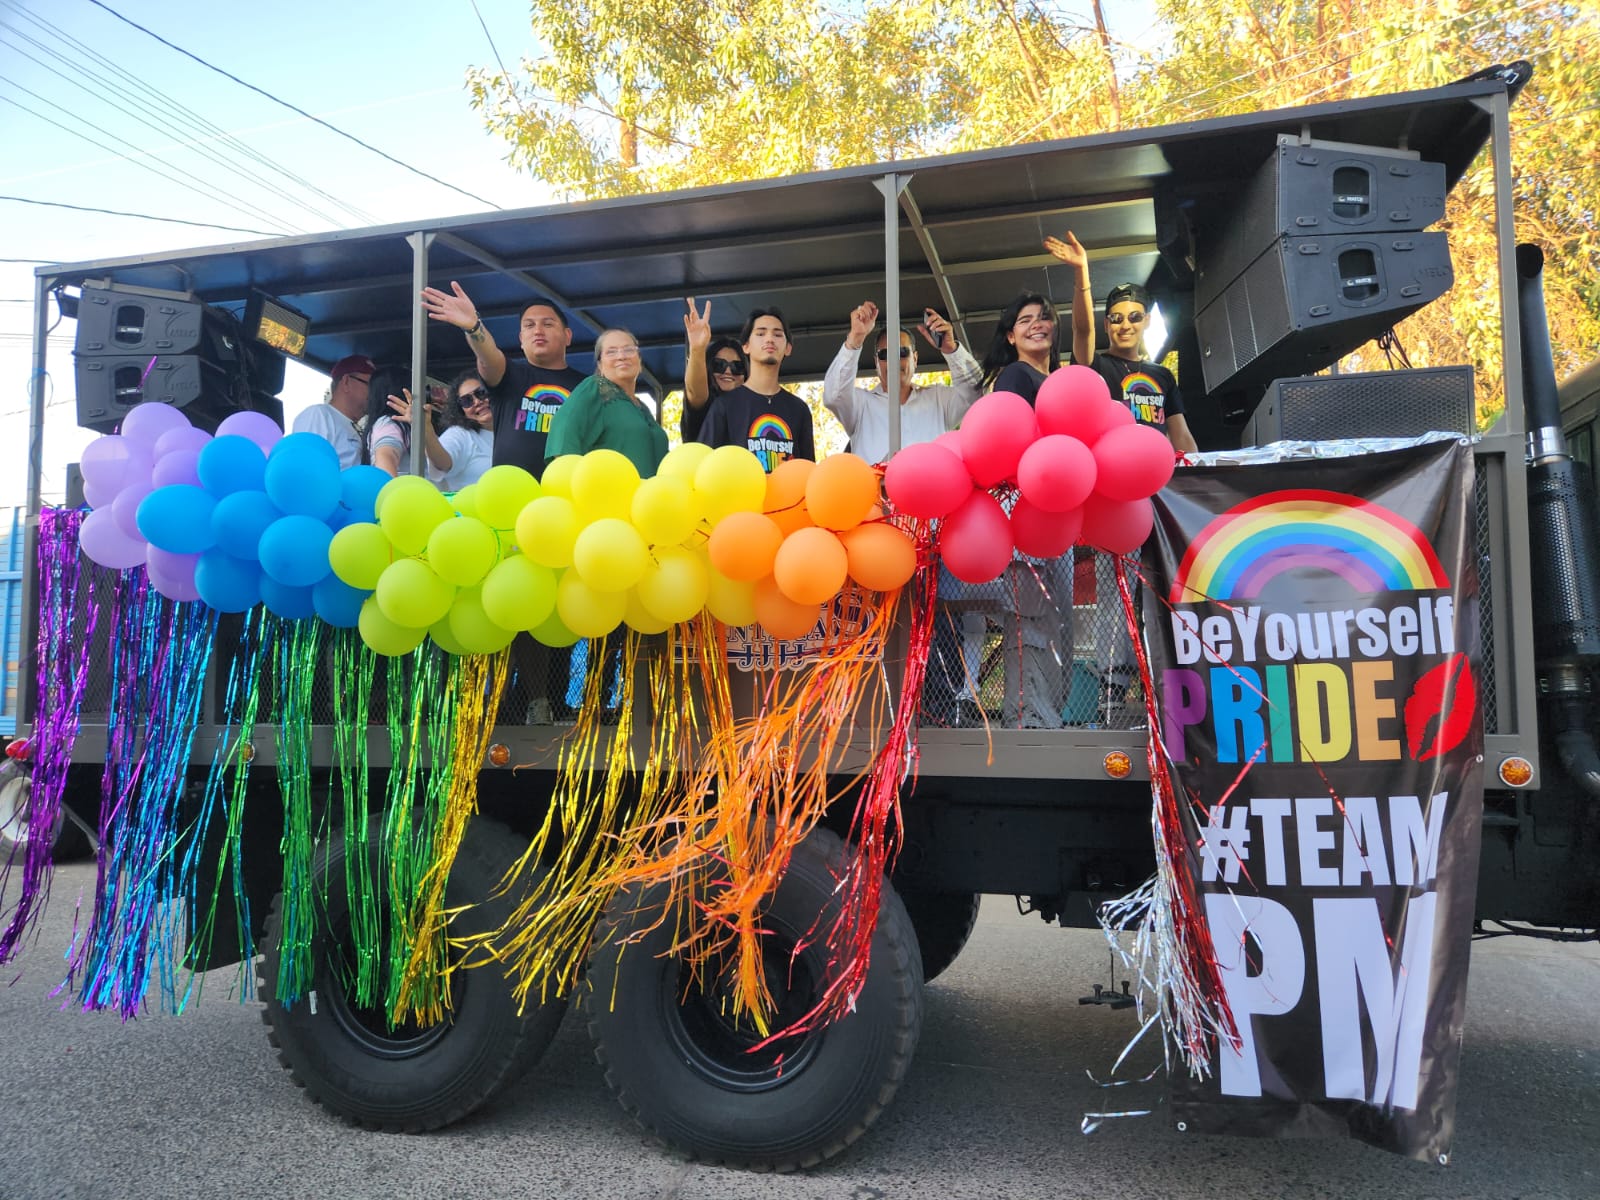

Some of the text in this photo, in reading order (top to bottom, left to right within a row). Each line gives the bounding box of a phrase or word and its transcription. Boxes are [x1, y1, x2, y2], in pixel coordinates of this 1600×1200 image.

[514, 409, 554, 433] PRID
[521, 397, 561, 414] BeYour
[747, 438, 793, 454] BeYourself
[755, 450, 786, 472] RIDE
[1171, 596, 1456, 664] BeYourself
[1162, 660, 1402, 763] PRIDE
[1200, 791, 1448, 887] #TEAM
[1204, 892, 1438, 1110] PM
